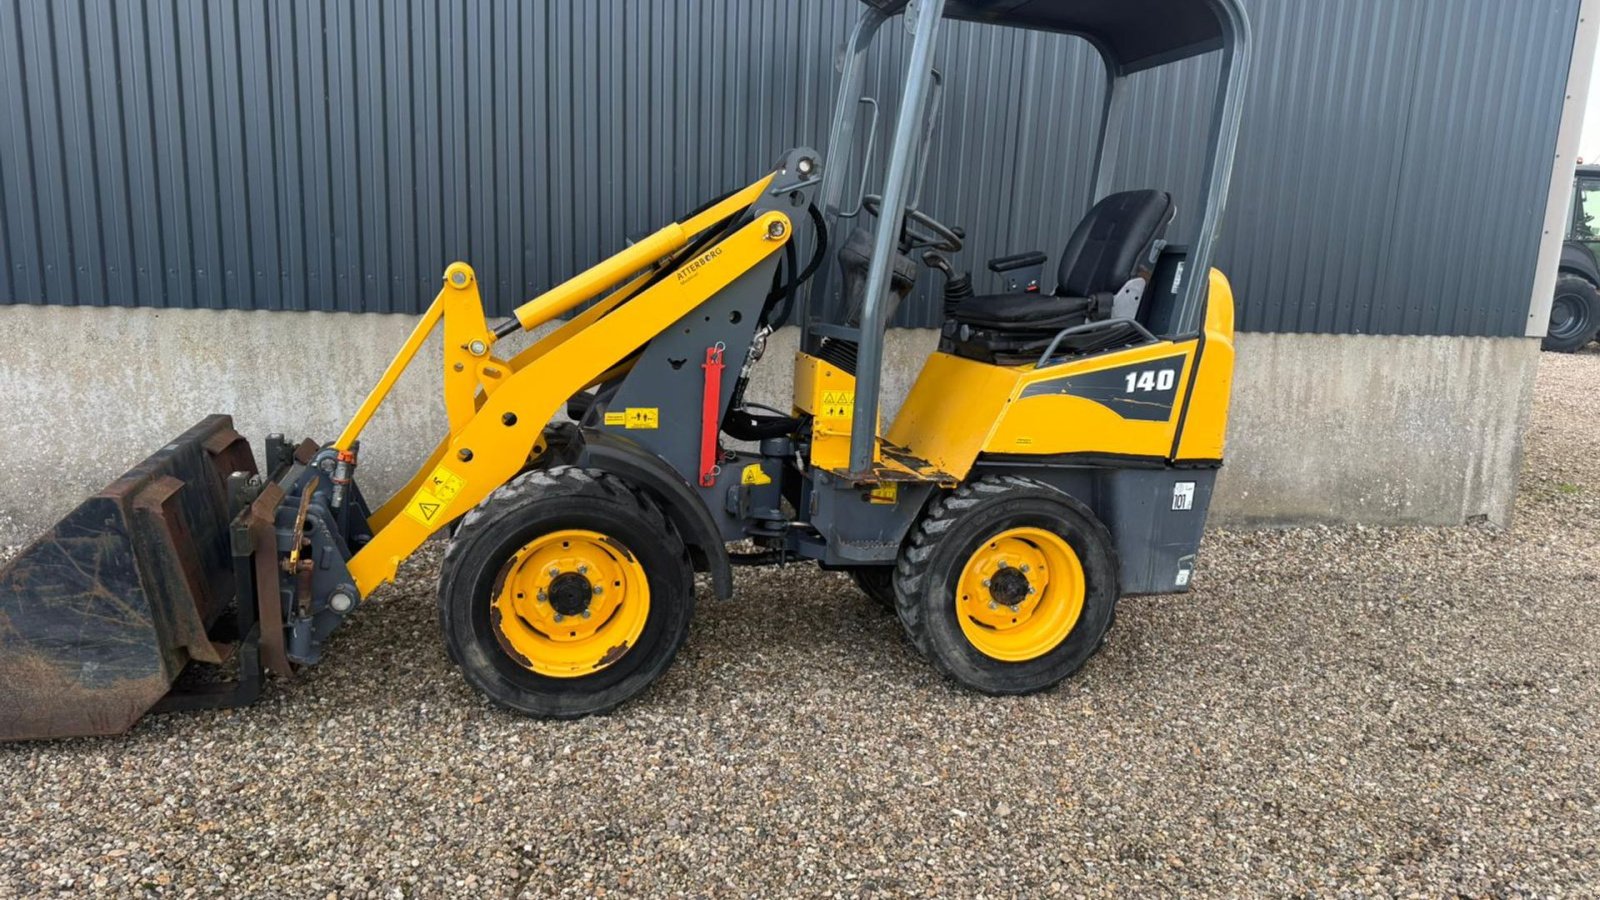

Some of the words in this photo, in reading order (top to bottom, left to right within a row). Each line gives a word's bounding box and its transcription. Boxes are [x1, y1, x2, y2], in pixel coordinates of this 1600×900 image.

[676, 247, 722, 281] ATTERBORG
[1125, 369, 1175, 393] 140
[1174, 494, 1186, 508] 101
